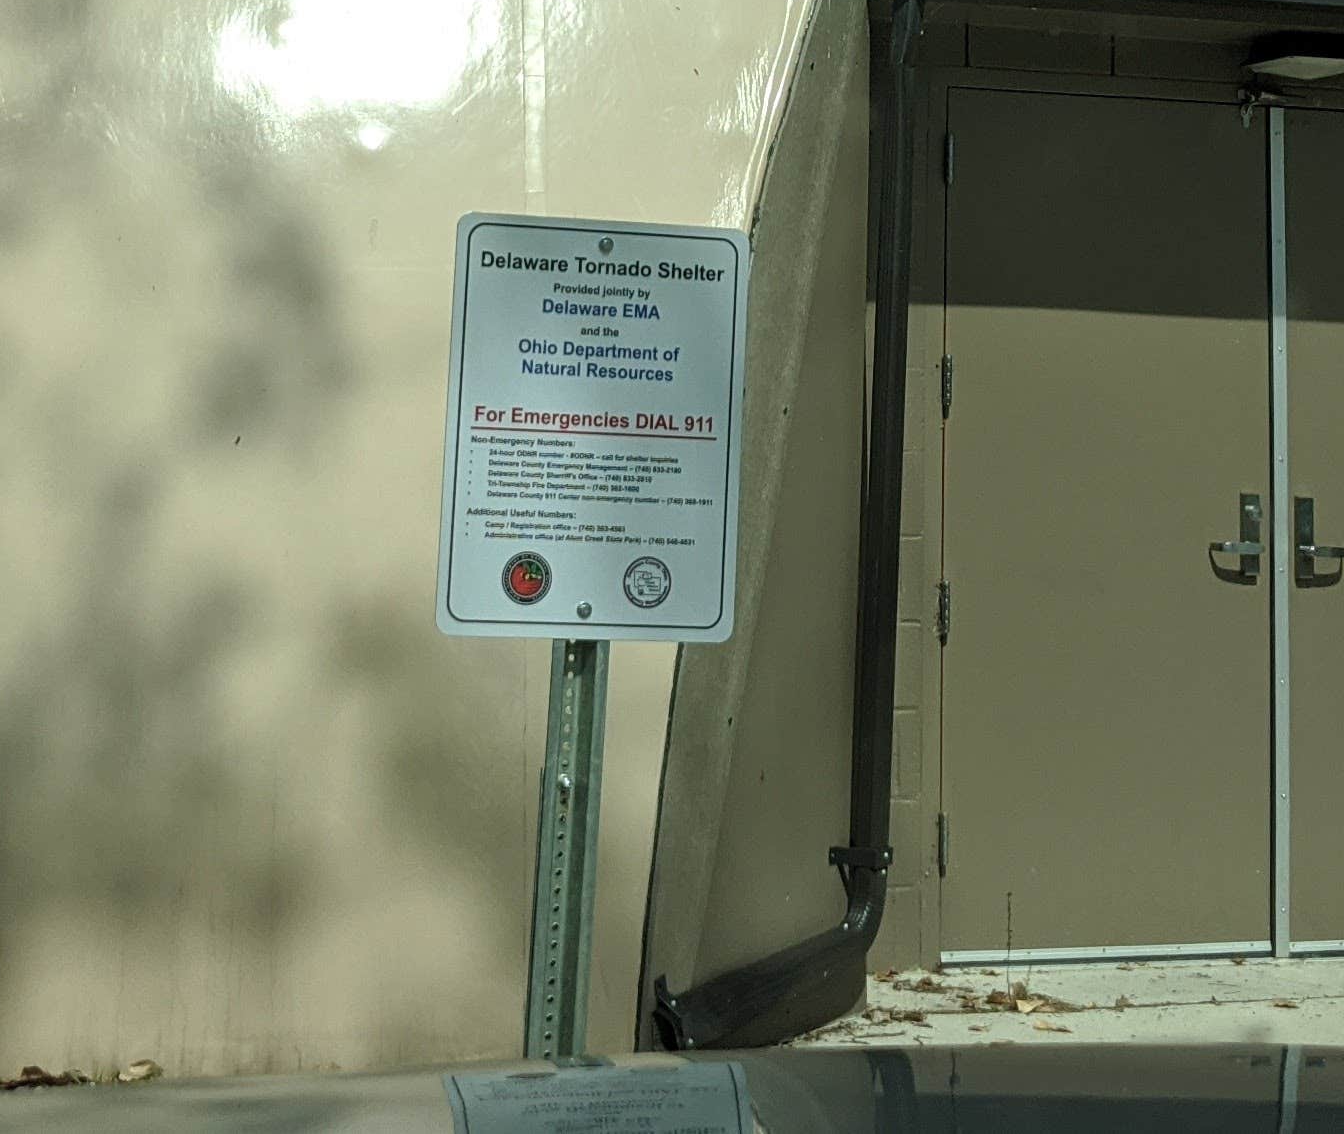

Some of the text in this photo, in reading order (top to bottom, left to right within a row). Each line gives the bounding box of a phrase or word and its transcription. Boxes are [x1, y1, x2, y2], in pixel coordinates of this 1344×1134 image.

[481, 250, 724, 282] Delaware Tornado Shelter
[553, 283, 650, 300] Provided jointly by
[542, 298, 660, 320] Delaware EMA
[580, 326, 619, 337] and the
[518, 338, 680, 362] Ohio Department of
[522, 359, 673, 381] Natural Resources
[474, 406, 713, 432] For Emergencies DIAL 911
[470, 435, 575, 448] Non-Emergency Numbers:
[466, 506, 576, 519] Additional Useful Numbers:
